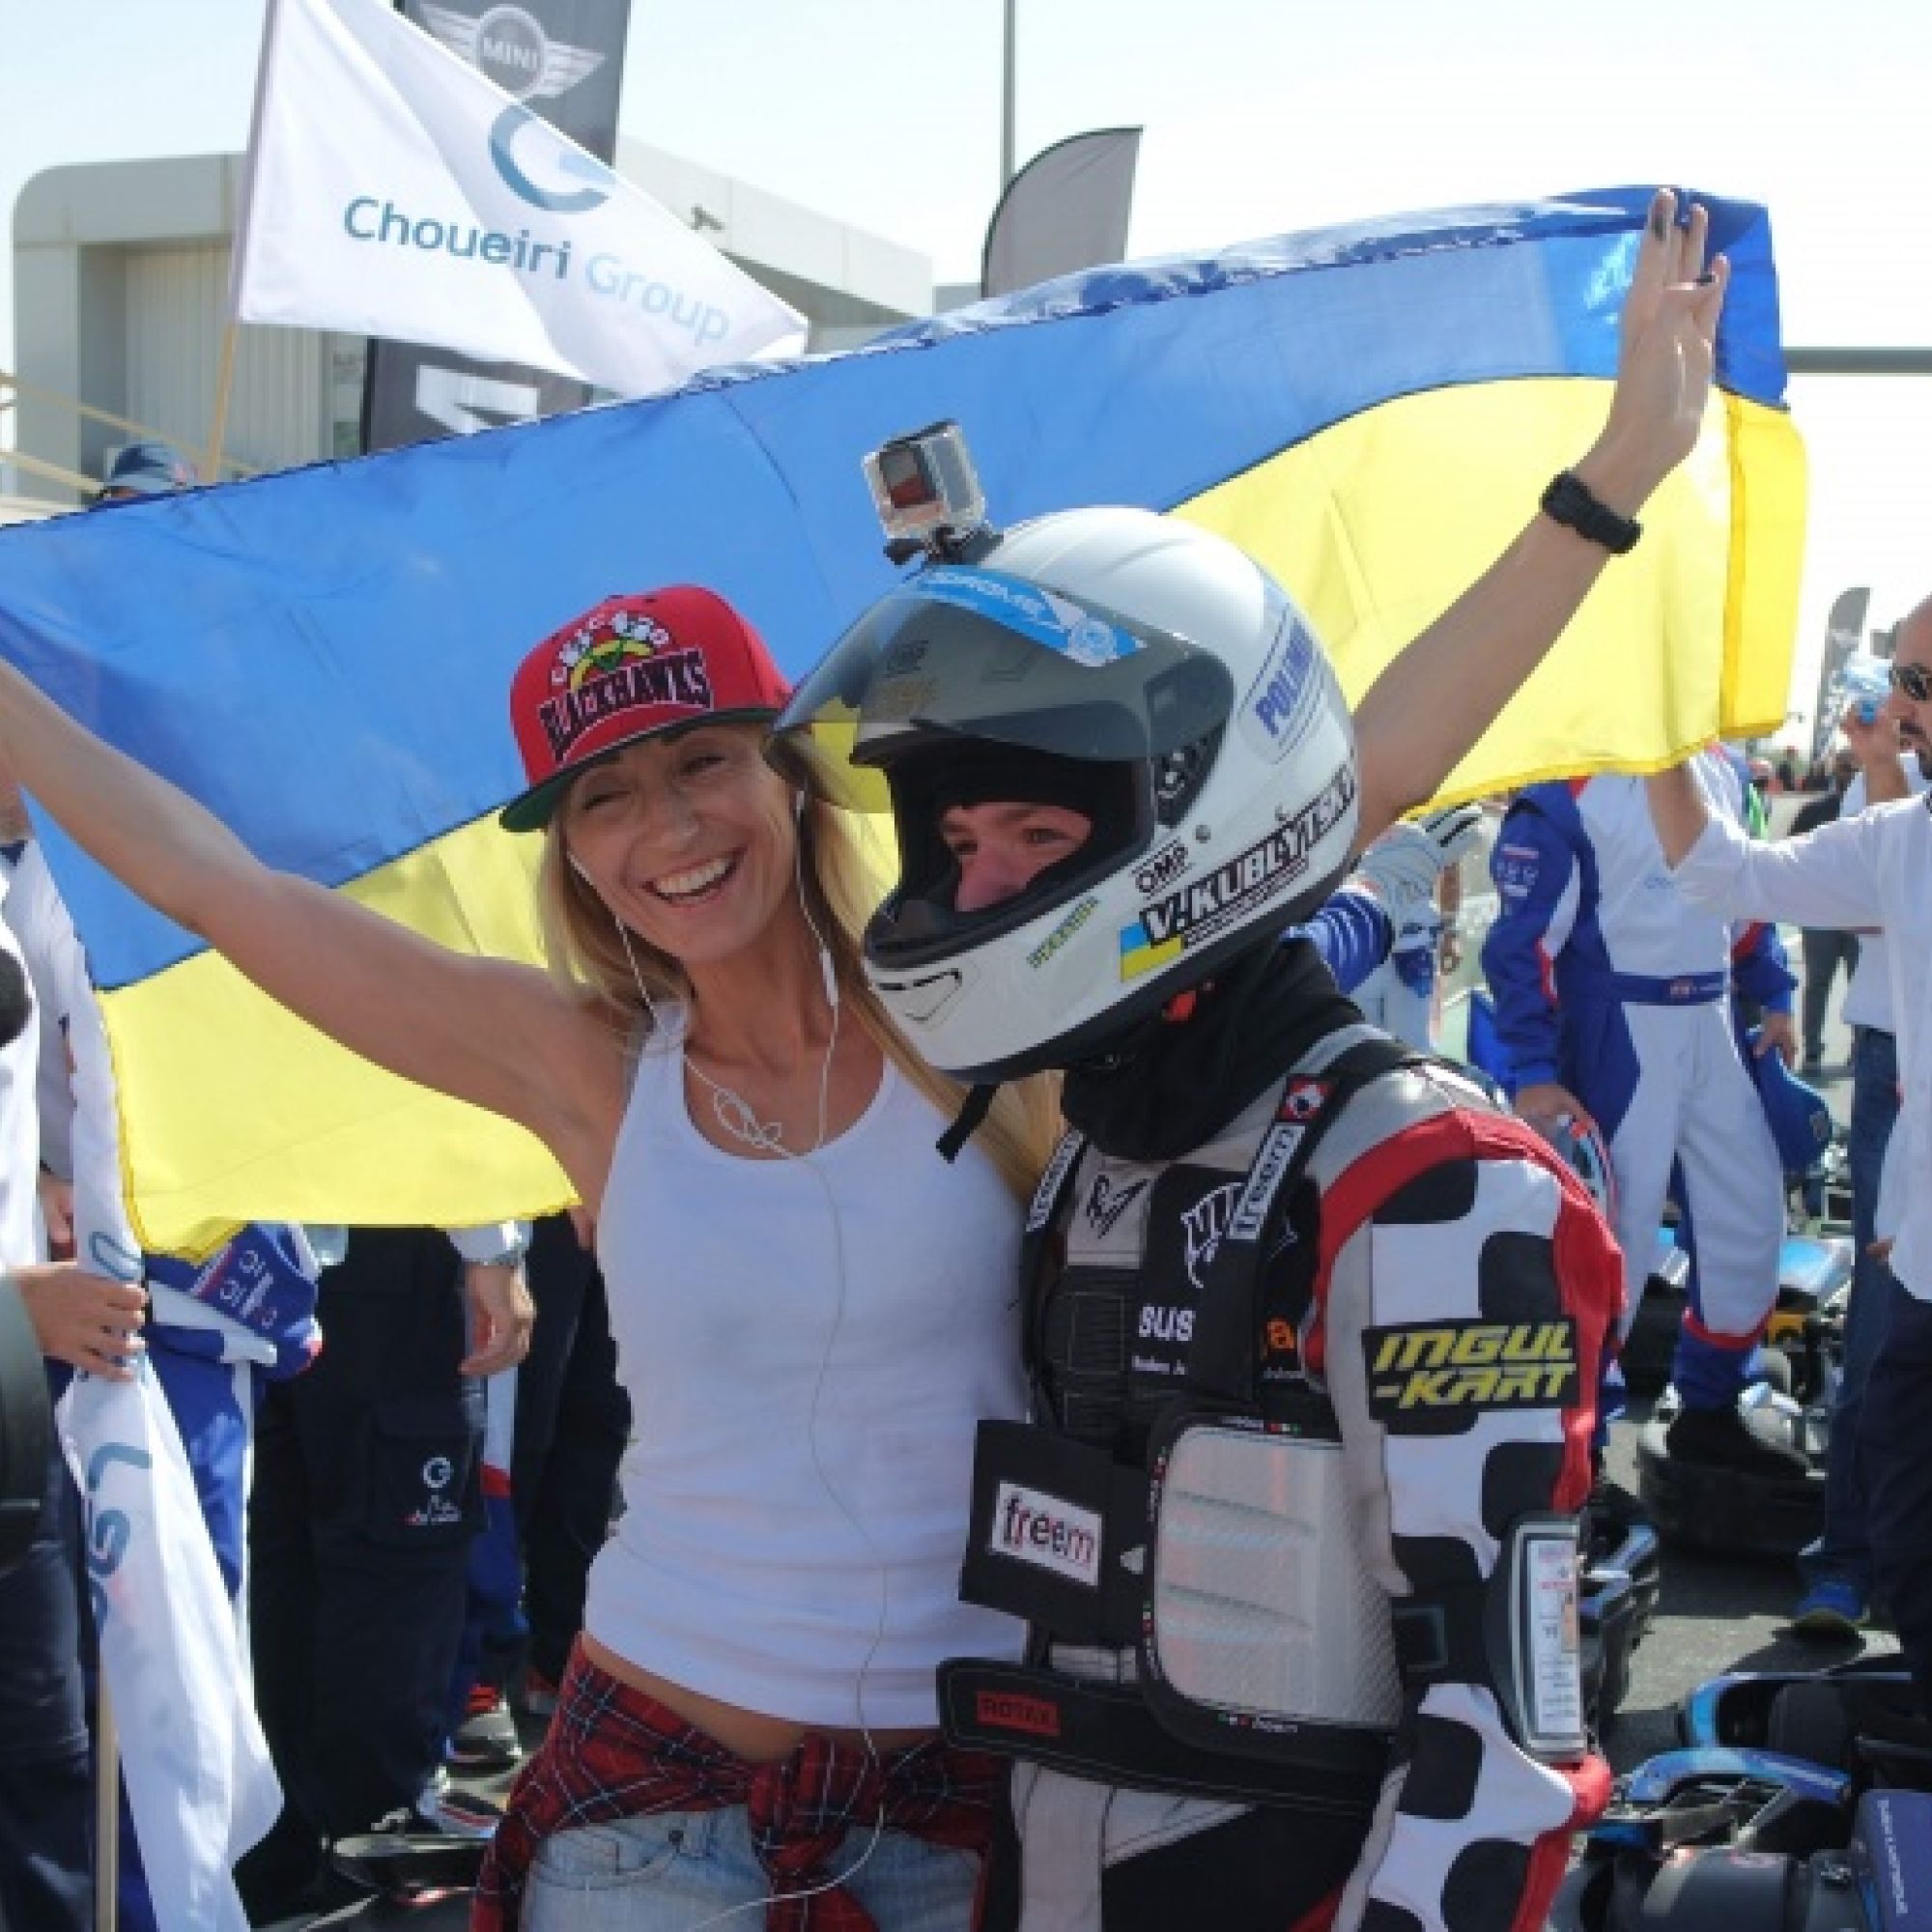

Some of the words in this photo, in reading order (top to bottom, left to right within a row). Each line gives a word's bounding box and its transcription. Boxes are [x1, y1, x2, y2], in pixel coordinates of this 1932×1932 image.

[482, 38, 540, 69] MINI
[343, 195, 573, 279] Choueiri
[584, 250, 731, 344] Group
[1134, 843, 1190, 896] OMP
[1373, 1324, 1571, 1373] INGUL
[1002, 1493, 1097, 1566] freem
